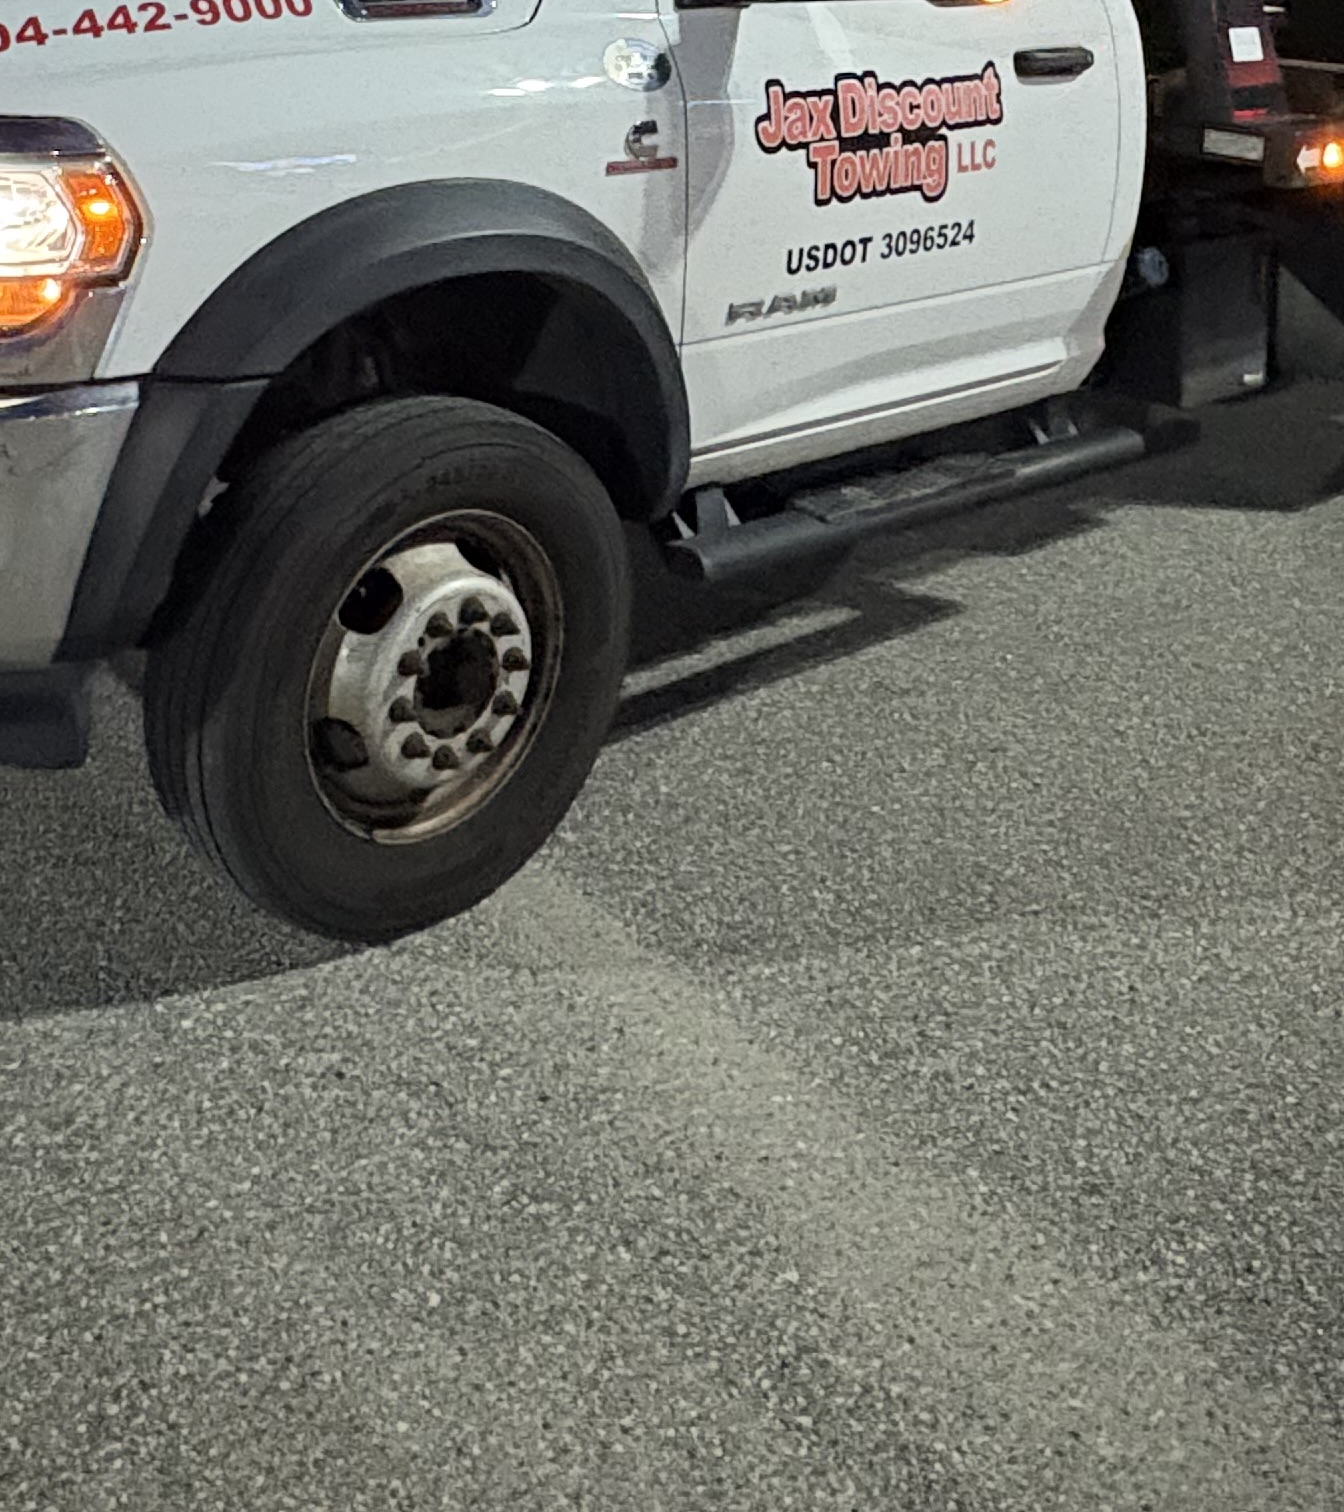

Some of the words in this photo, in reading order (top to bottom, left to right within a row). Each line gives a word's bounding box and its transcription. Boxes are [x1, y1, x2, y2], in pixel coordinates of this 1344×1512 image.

[757, 83, 836, 149] Jax
[837, 66, 1001, 135] Discount
[810, 133, 947, 201] Towing
[956, 139, 996, 174] LLC
[785, 236, 873, 276] USDOT
[880, 219, 977, 260] 3096524
[725, 284, 838, 326] RAM
